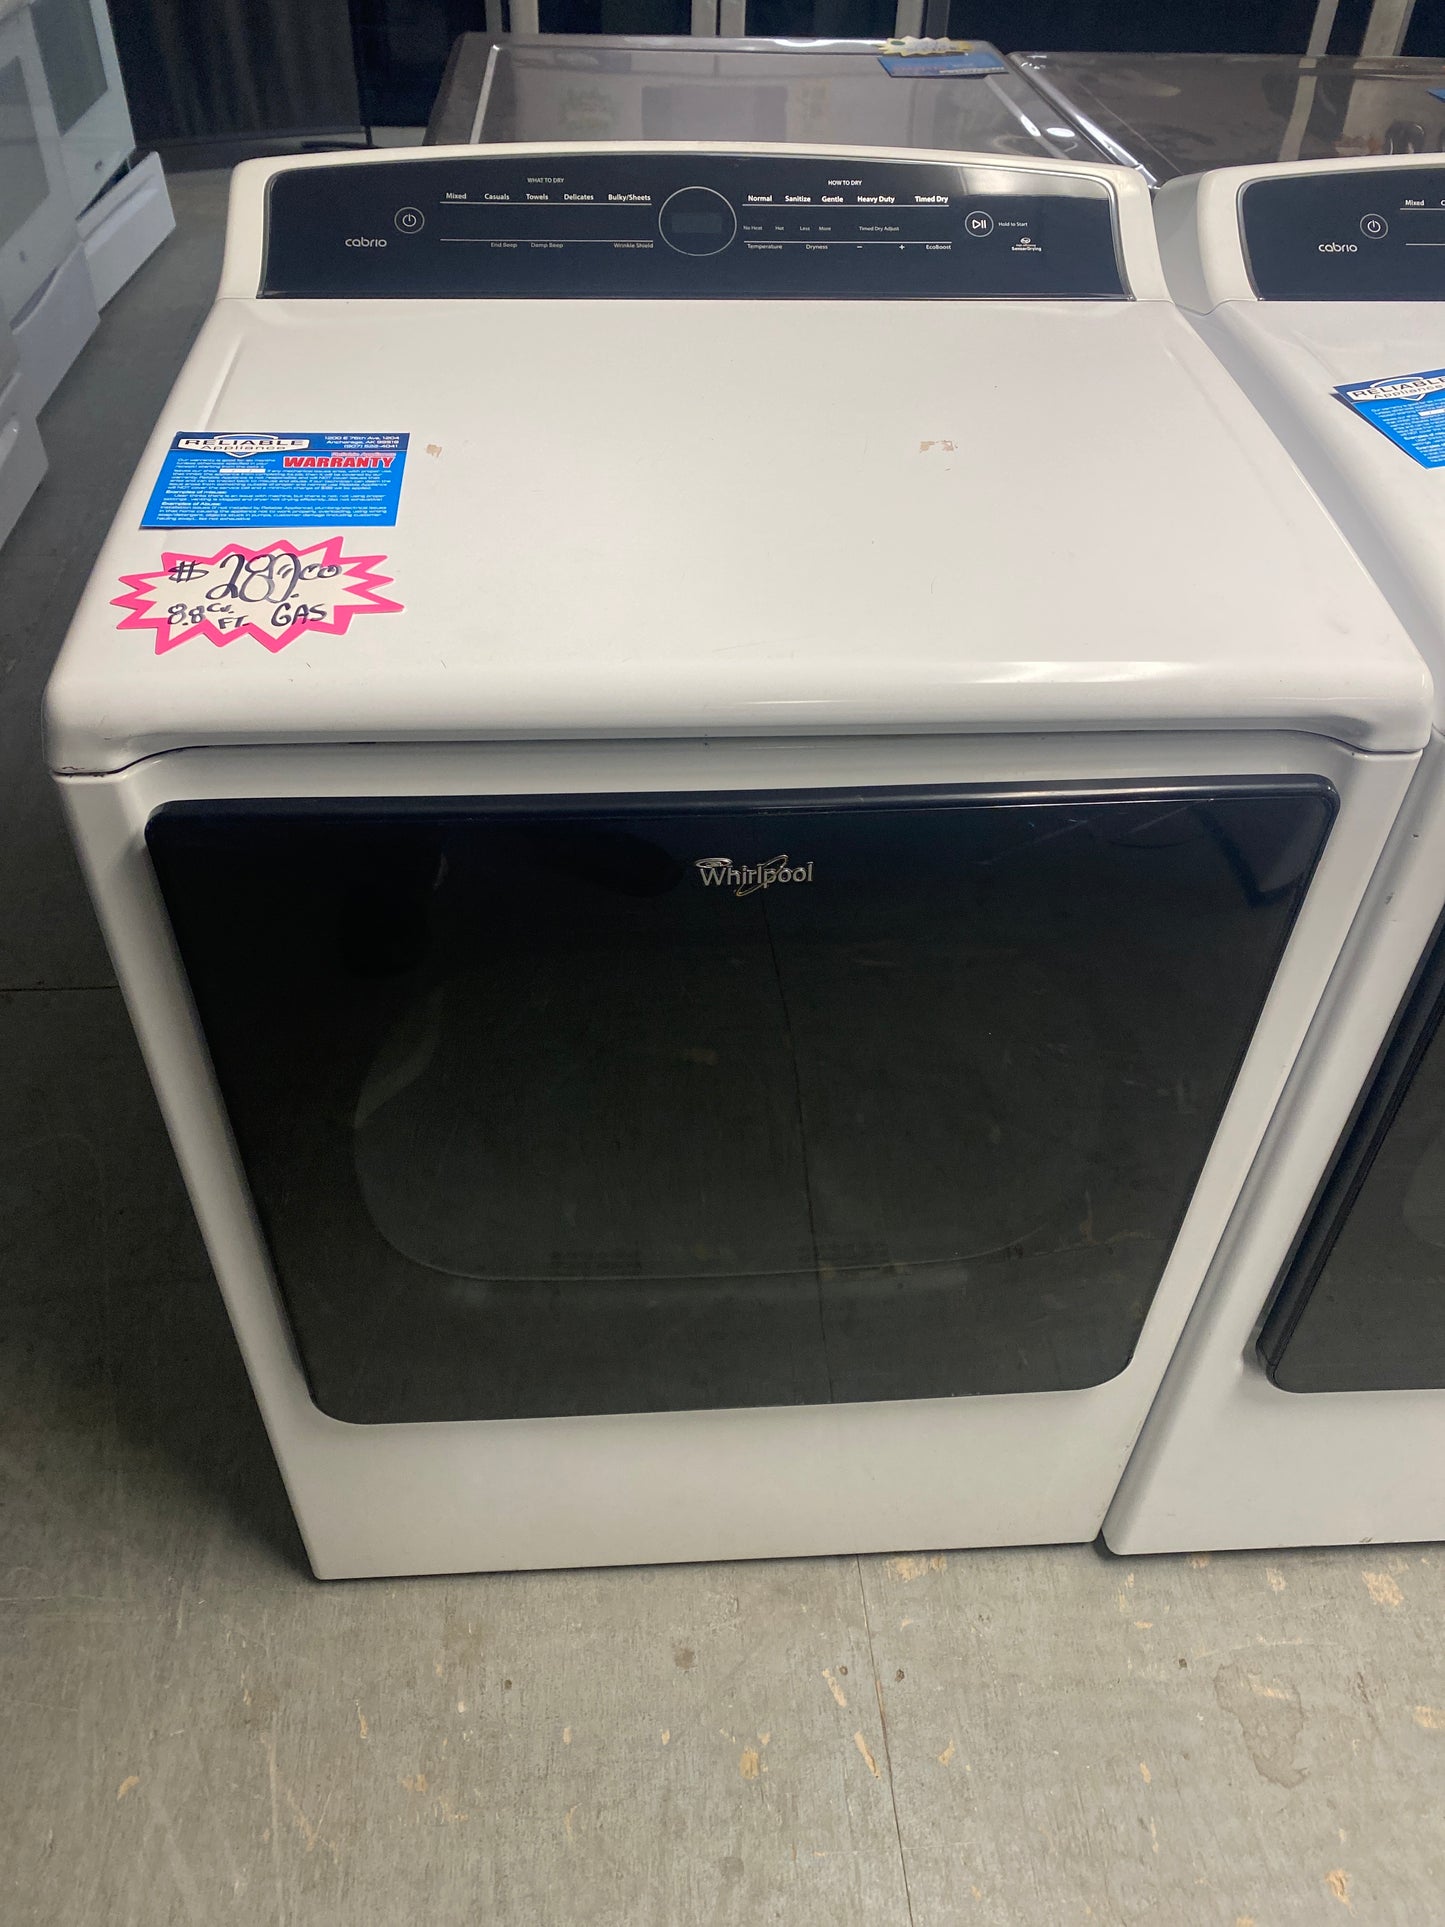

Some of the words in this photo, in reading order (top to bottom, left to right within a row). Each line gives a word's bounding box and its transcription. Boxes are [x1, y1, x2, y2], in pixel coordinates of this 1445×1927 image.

[608, 193, 651, 202] Bulky/Sheets
[345, 236, 387, 247] cabrio
[1318, 242, 1358, 253] cabrio
[1374, 385, 1443, 399] Appliance
[283, 456, 395, 469] WARRANTY
[167, 602, 206, 626] 8.8
[270, 601, 328, 627] GAS
[699, 859, 815, 890] Whirlpool
